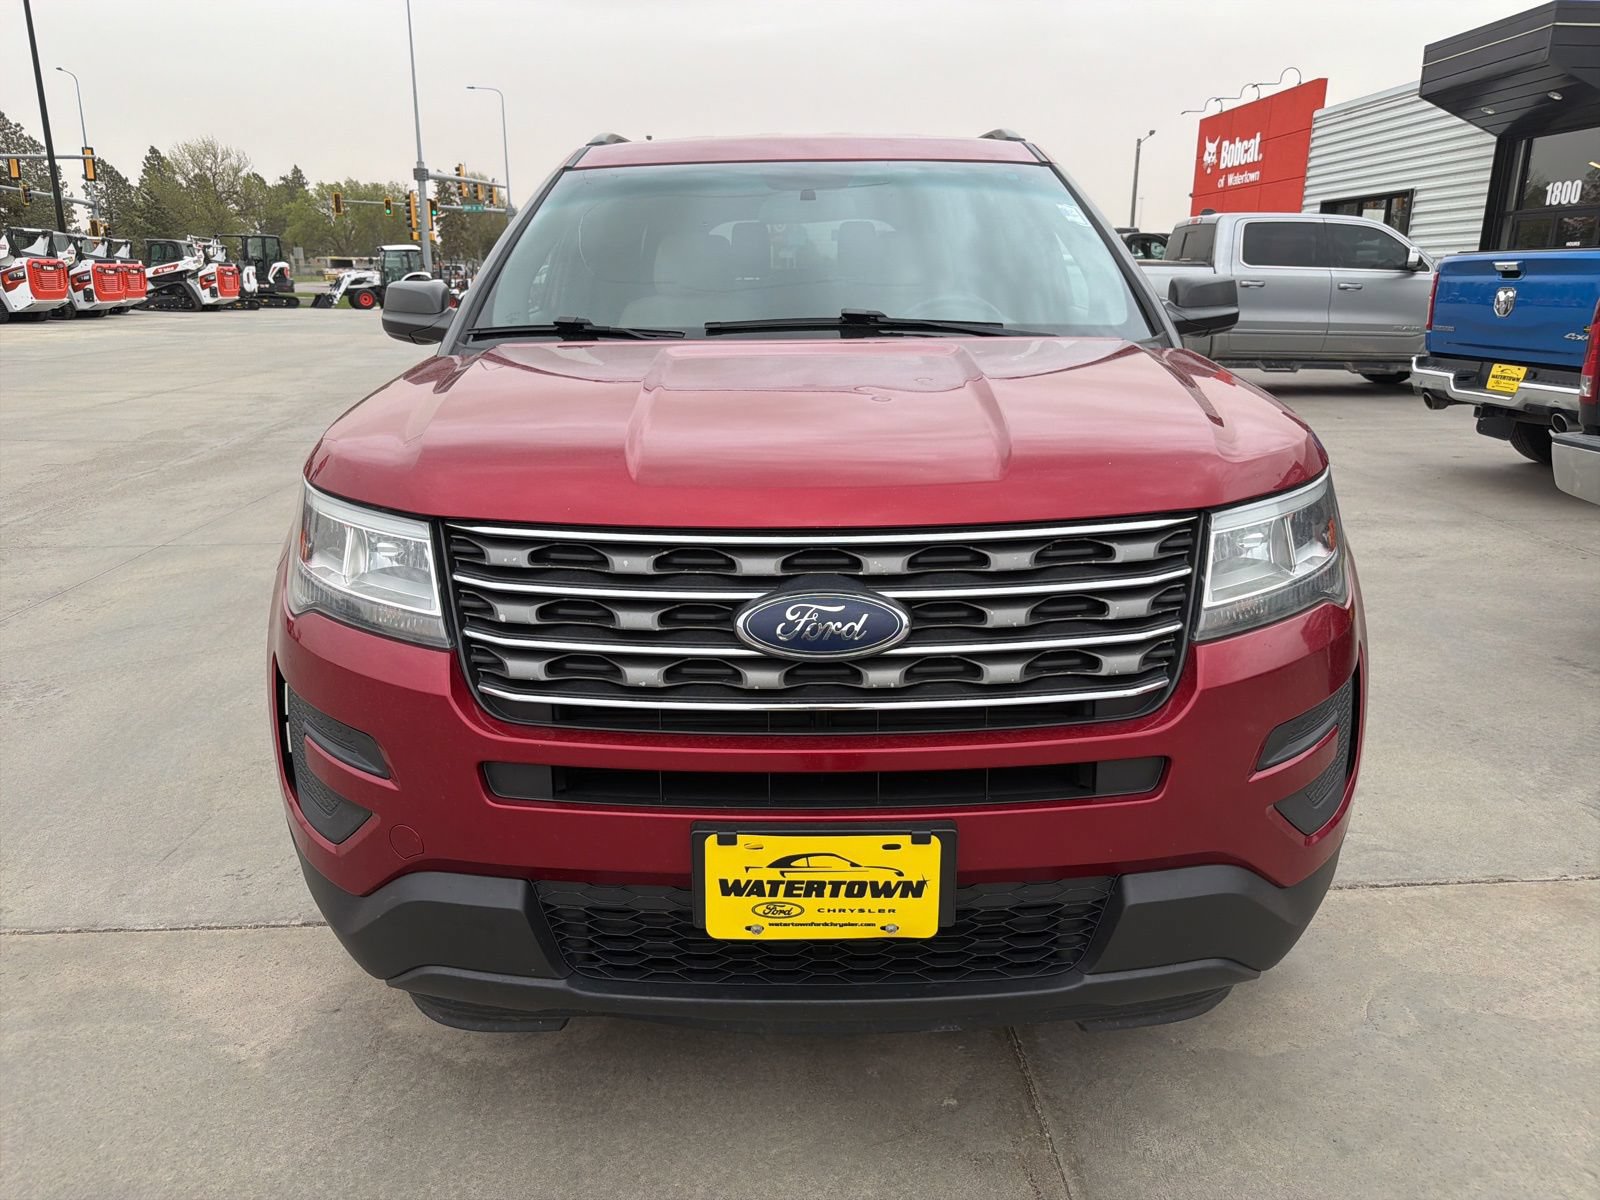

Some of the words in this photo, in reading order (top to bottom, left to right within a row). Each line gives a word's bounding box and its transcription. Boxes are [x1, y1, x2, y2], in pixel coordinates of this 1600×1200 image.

[1217, 174, 1226, 188] of
[1227, 170, 1260, 187] Watertown
[1545, 180, 1582, 206] 1800
[776, 603, 869, 642] Ford
[718, 878, 927, 899] WATERTOWN
[762, 904, 794, 916] Ford
